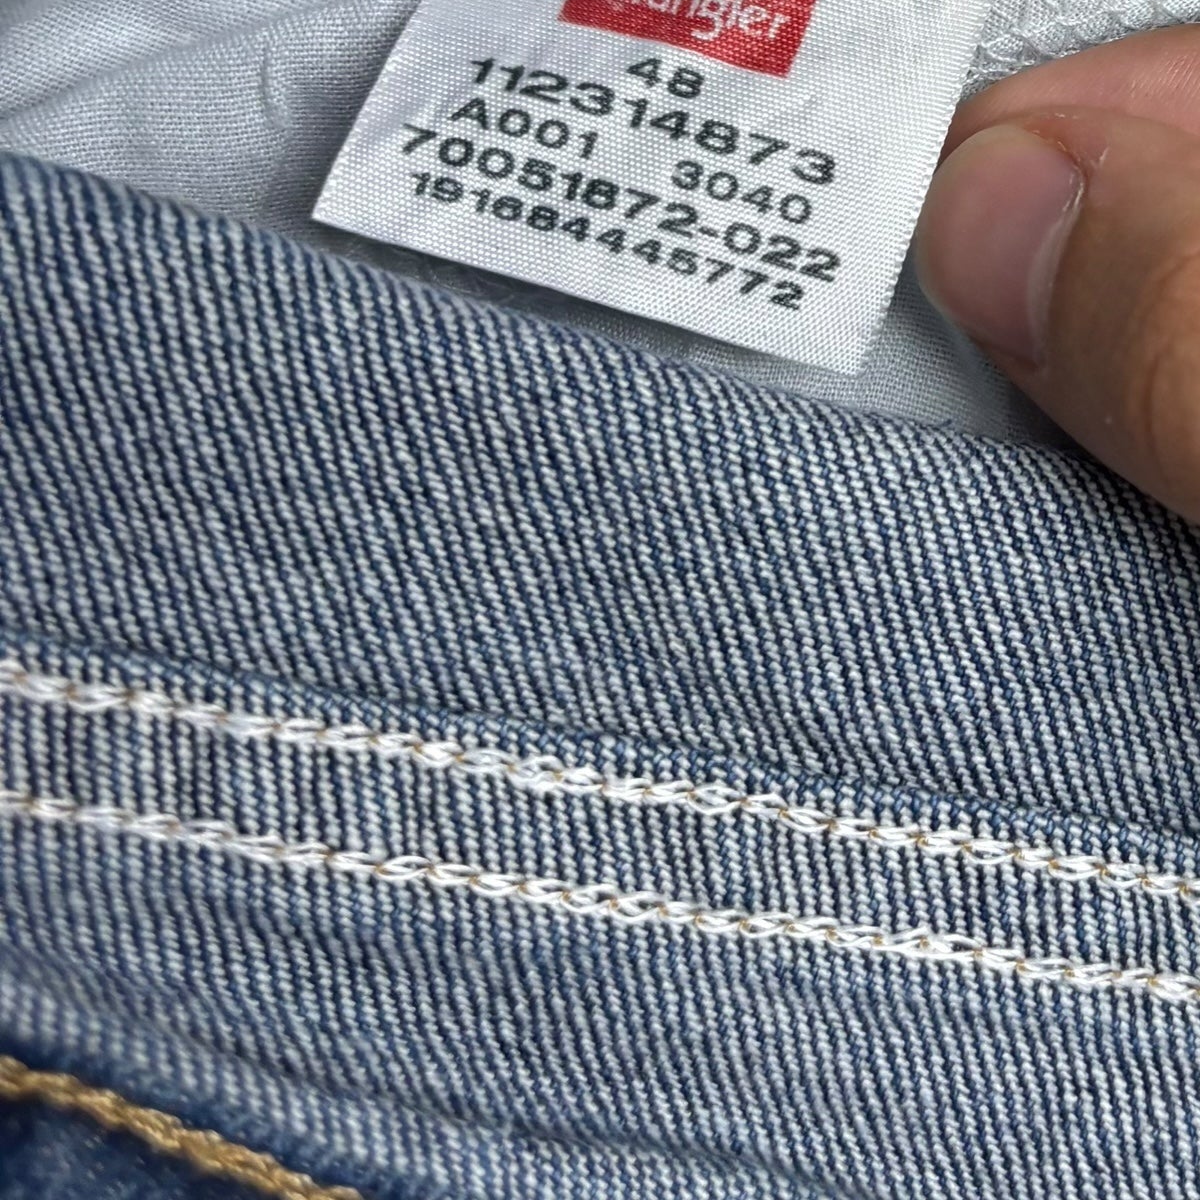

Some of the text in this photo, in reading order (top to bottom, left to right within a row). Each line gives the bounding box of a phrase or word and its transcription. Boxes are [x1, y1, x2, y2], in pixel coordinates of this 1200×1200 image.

[470, 58, 838, 186] 112314873
[626, 57, 704, 100] 48
[400, 123, 842, 283] 70051872-022
[450, 98, 813, 225] A001 3040
